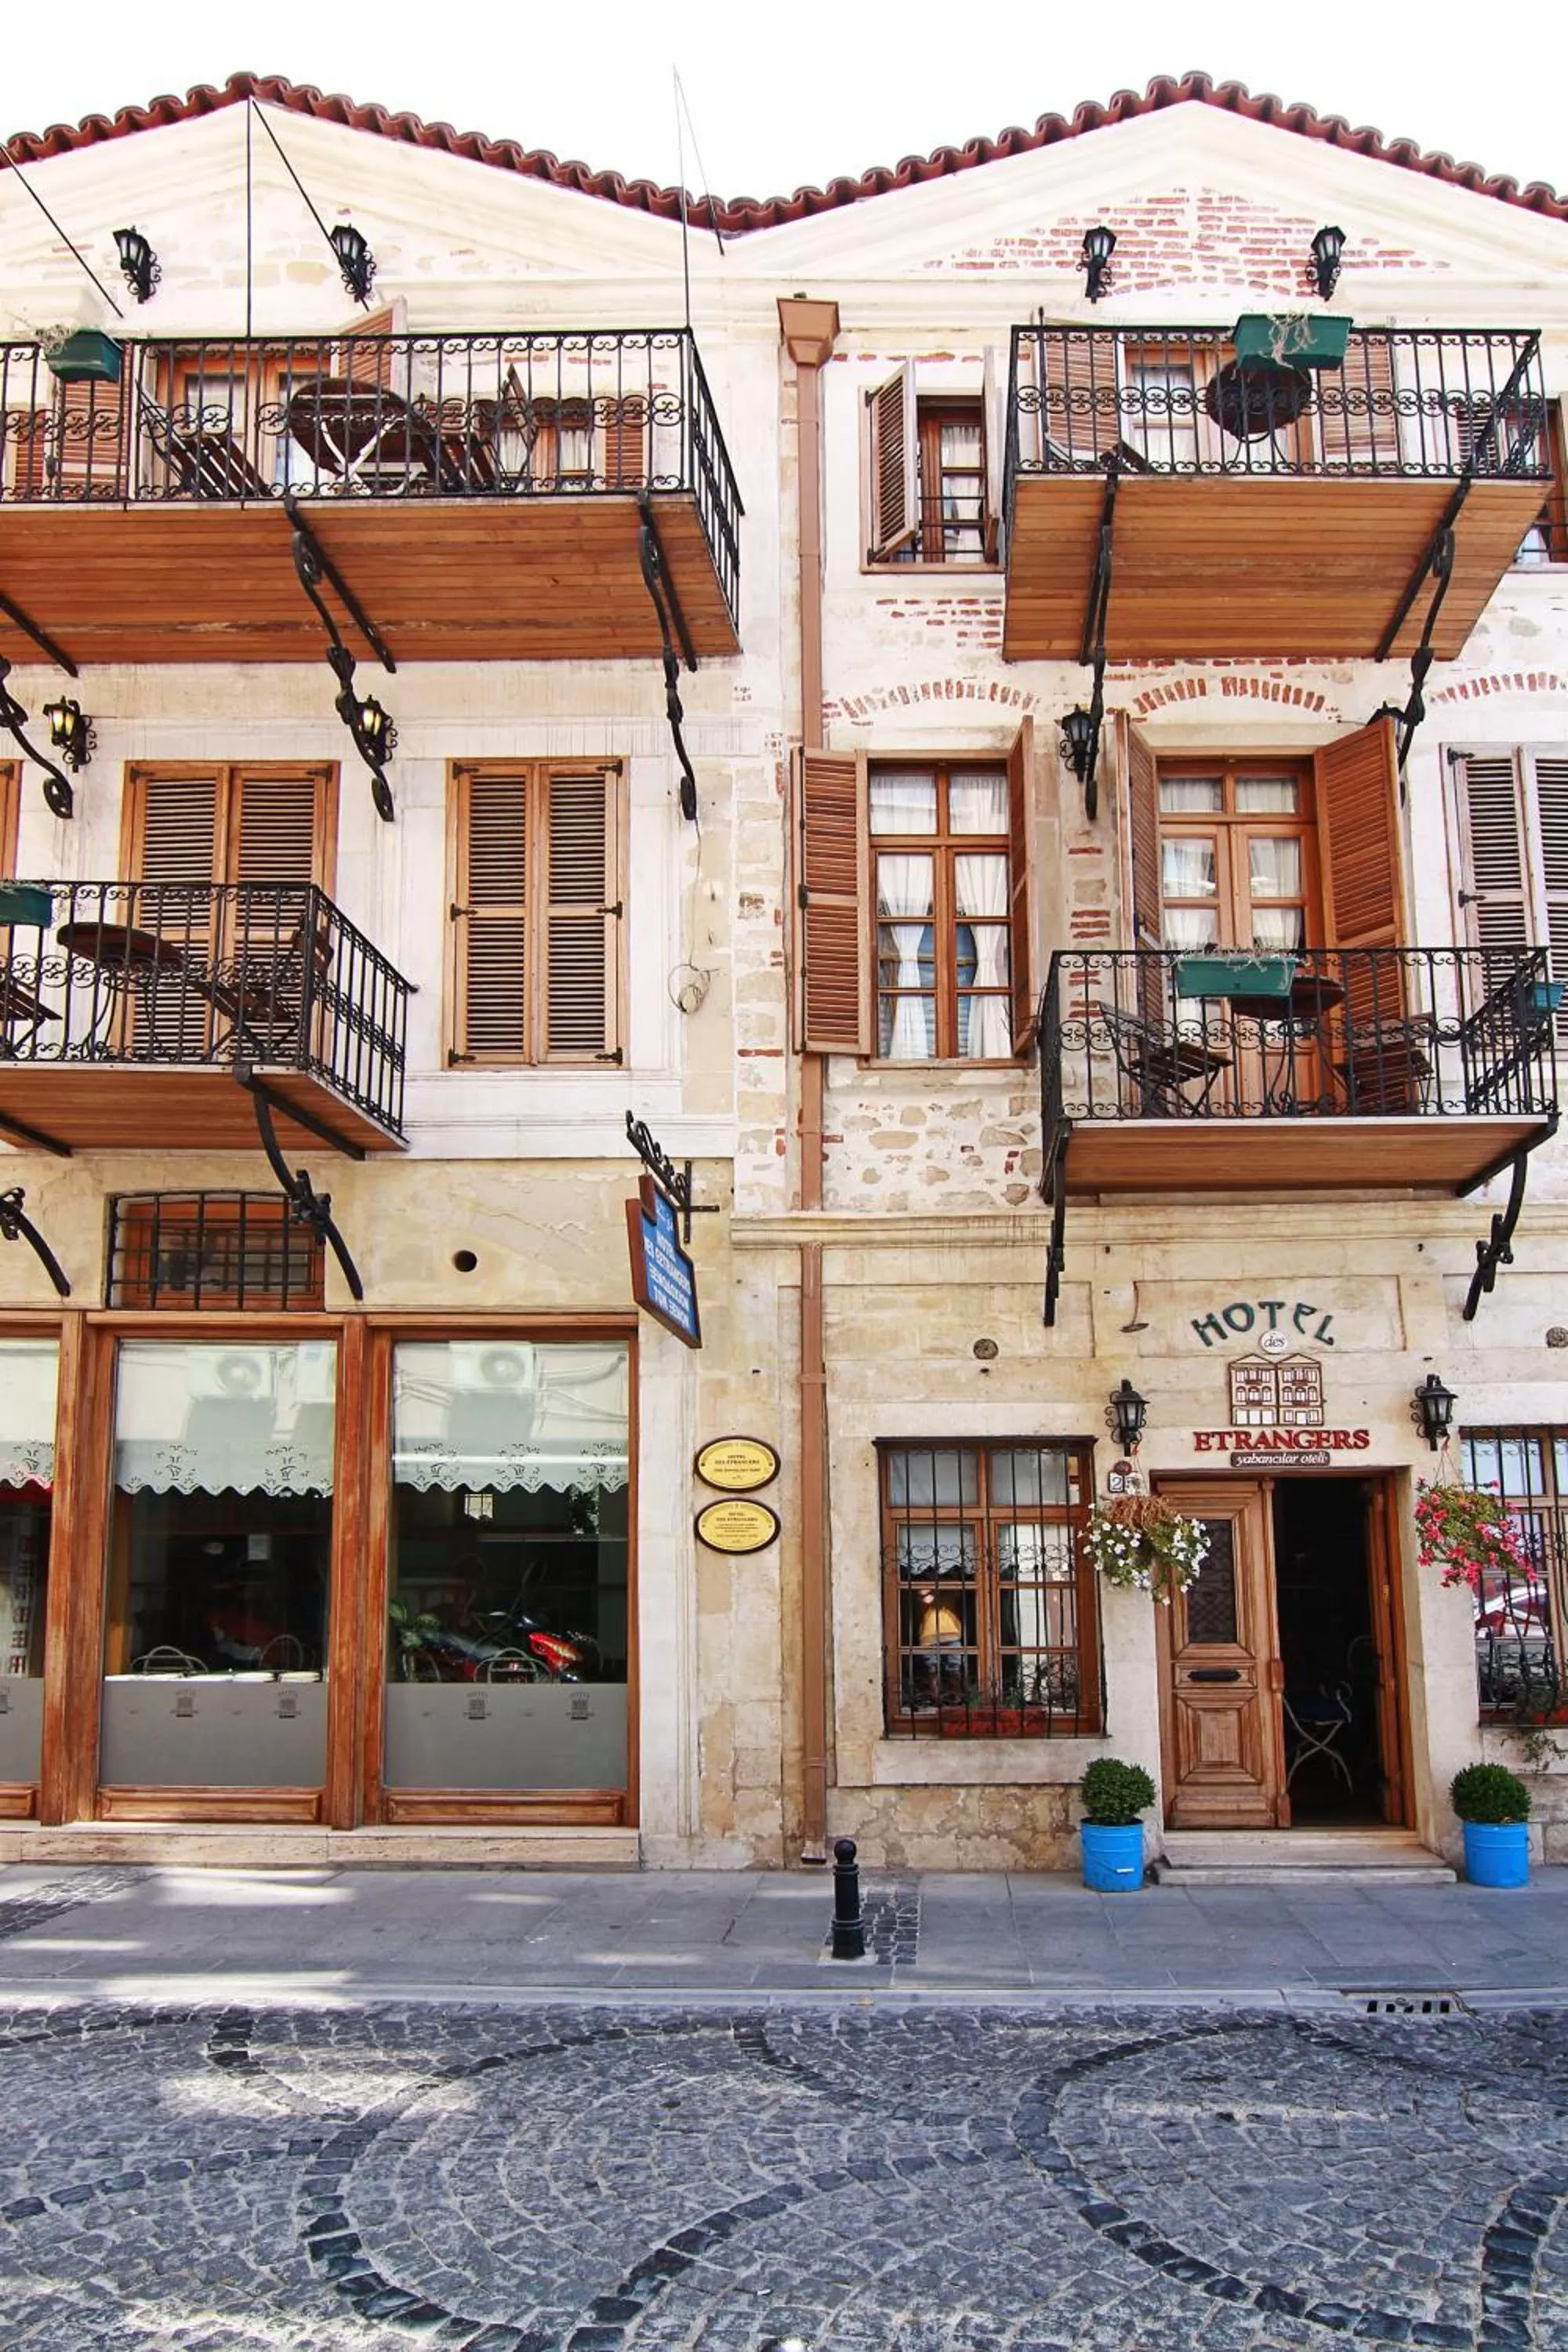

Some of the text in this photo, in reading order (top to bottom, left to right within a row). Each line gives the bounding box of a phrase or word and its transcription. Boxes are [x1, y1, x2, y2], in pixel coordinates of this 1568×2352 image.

[1190, 1301, 1335, 1347] HOTEL
[1264, 1334, 1286, 1348] des
[1192, 1429, 1370, 1452] ETRANGERS
